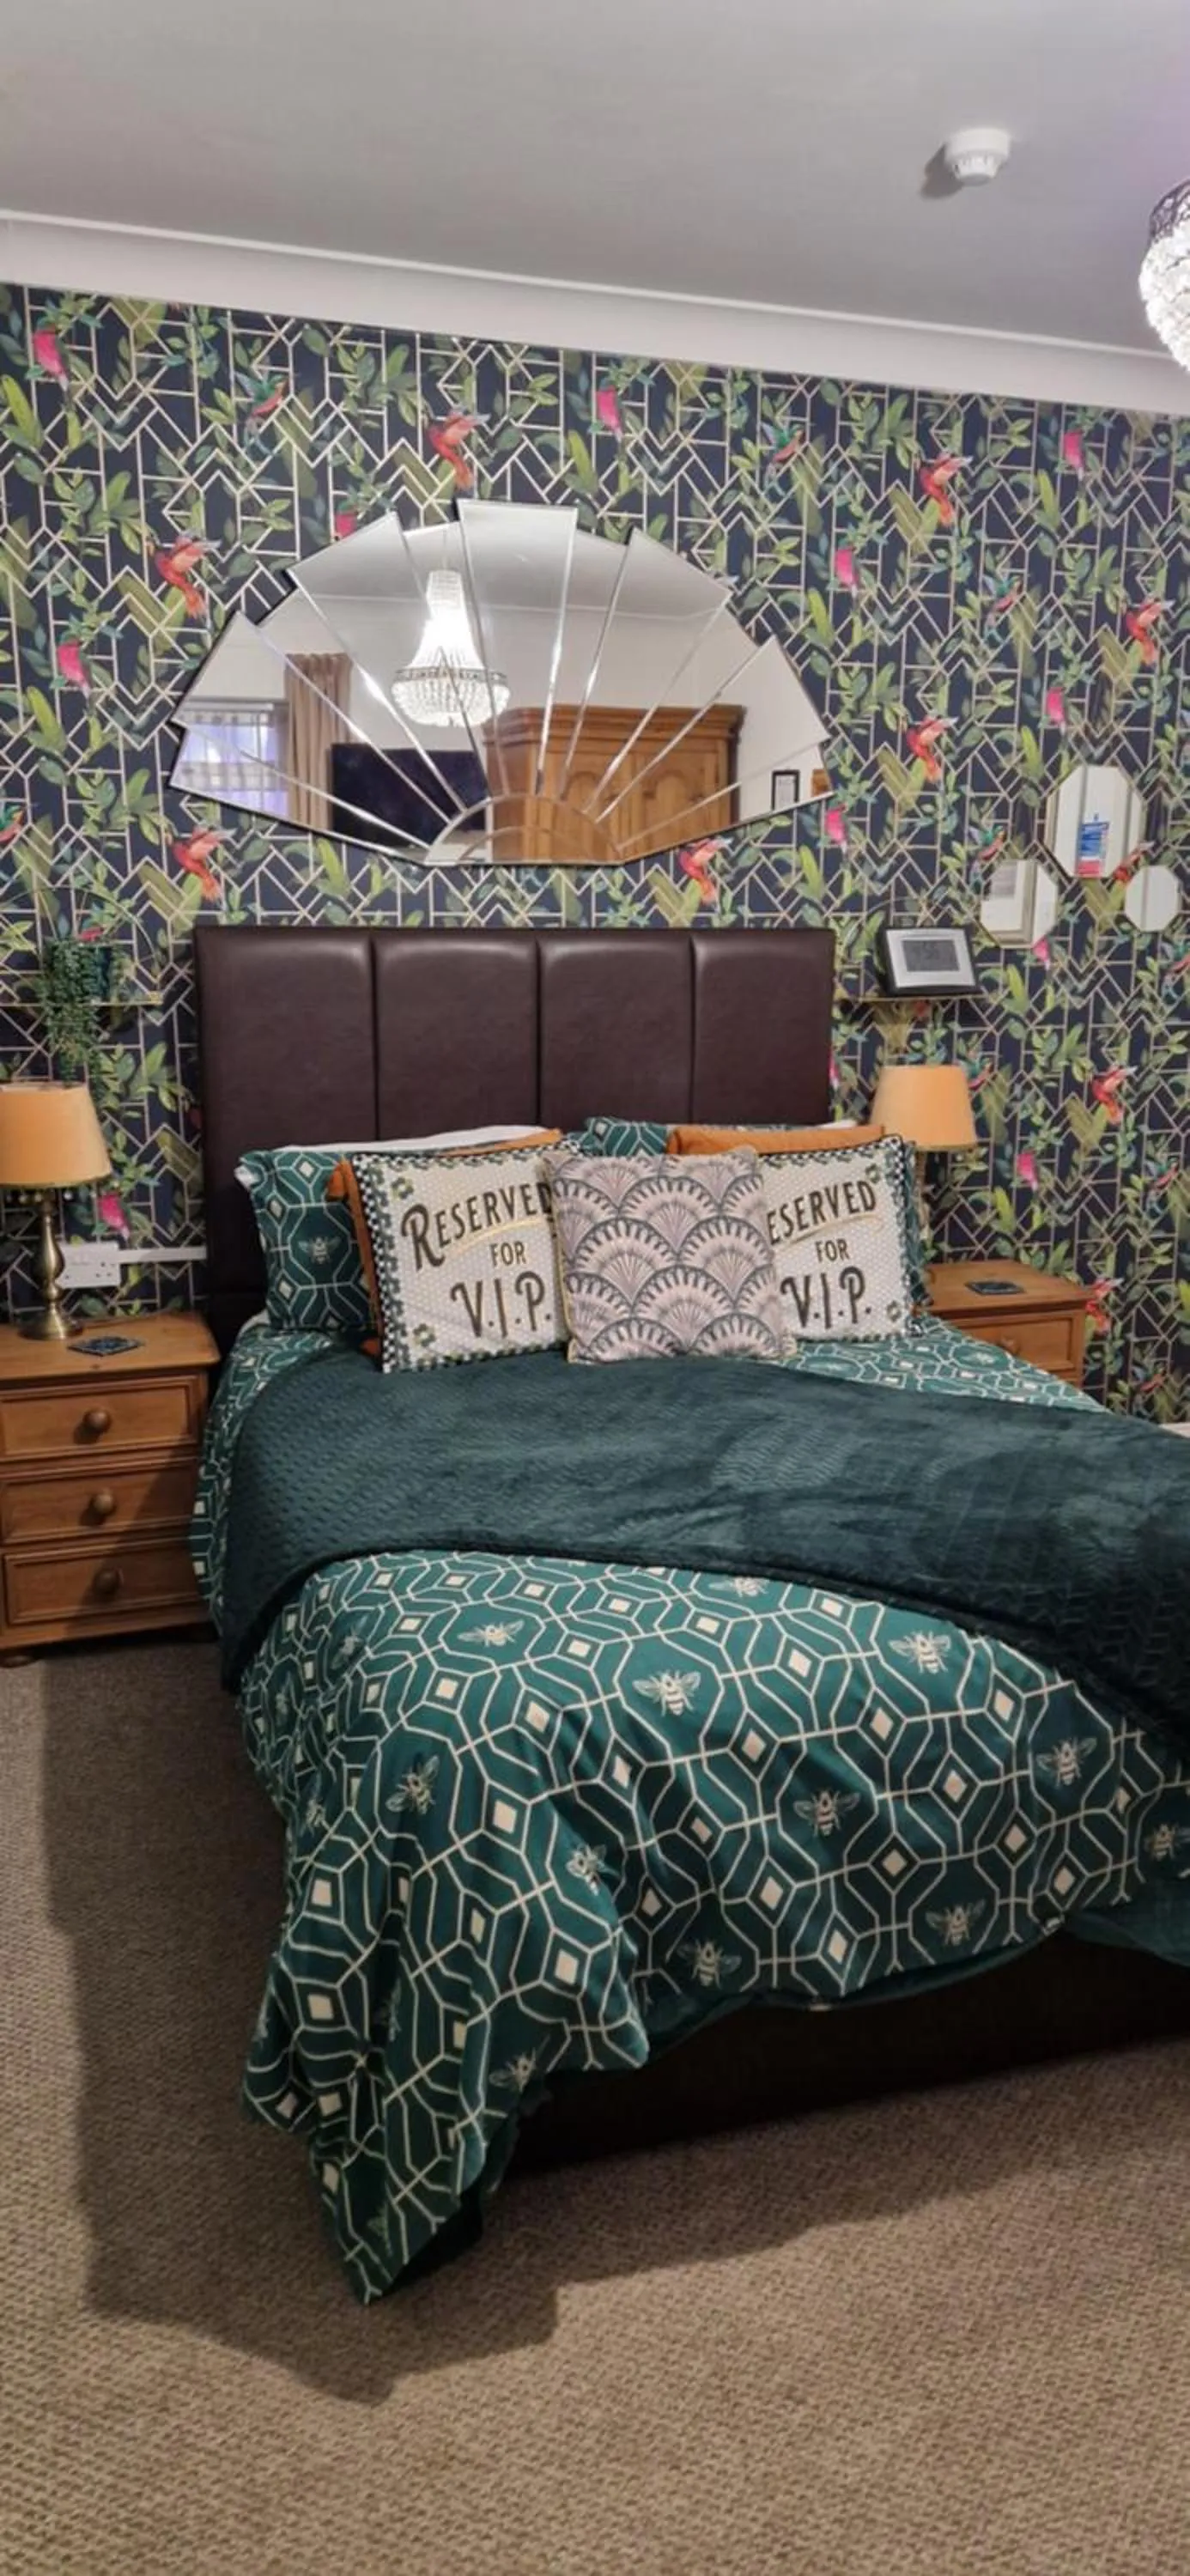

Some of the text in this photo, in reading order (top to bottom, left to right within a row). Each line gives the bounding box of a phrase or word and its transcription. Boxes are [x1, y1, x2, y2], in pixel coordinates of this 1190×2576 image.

[401, 1182, 550, 1271] RESERVED
[767, 1181, 876, 1245] ESERVED
[490, 1242, 526, 1267] FOR
[816, 1239, 849, 1262] FOR
[451, 1272, 550, 1337] V.I.P.
[780, 1267, 871, 1328] V.I.P.
